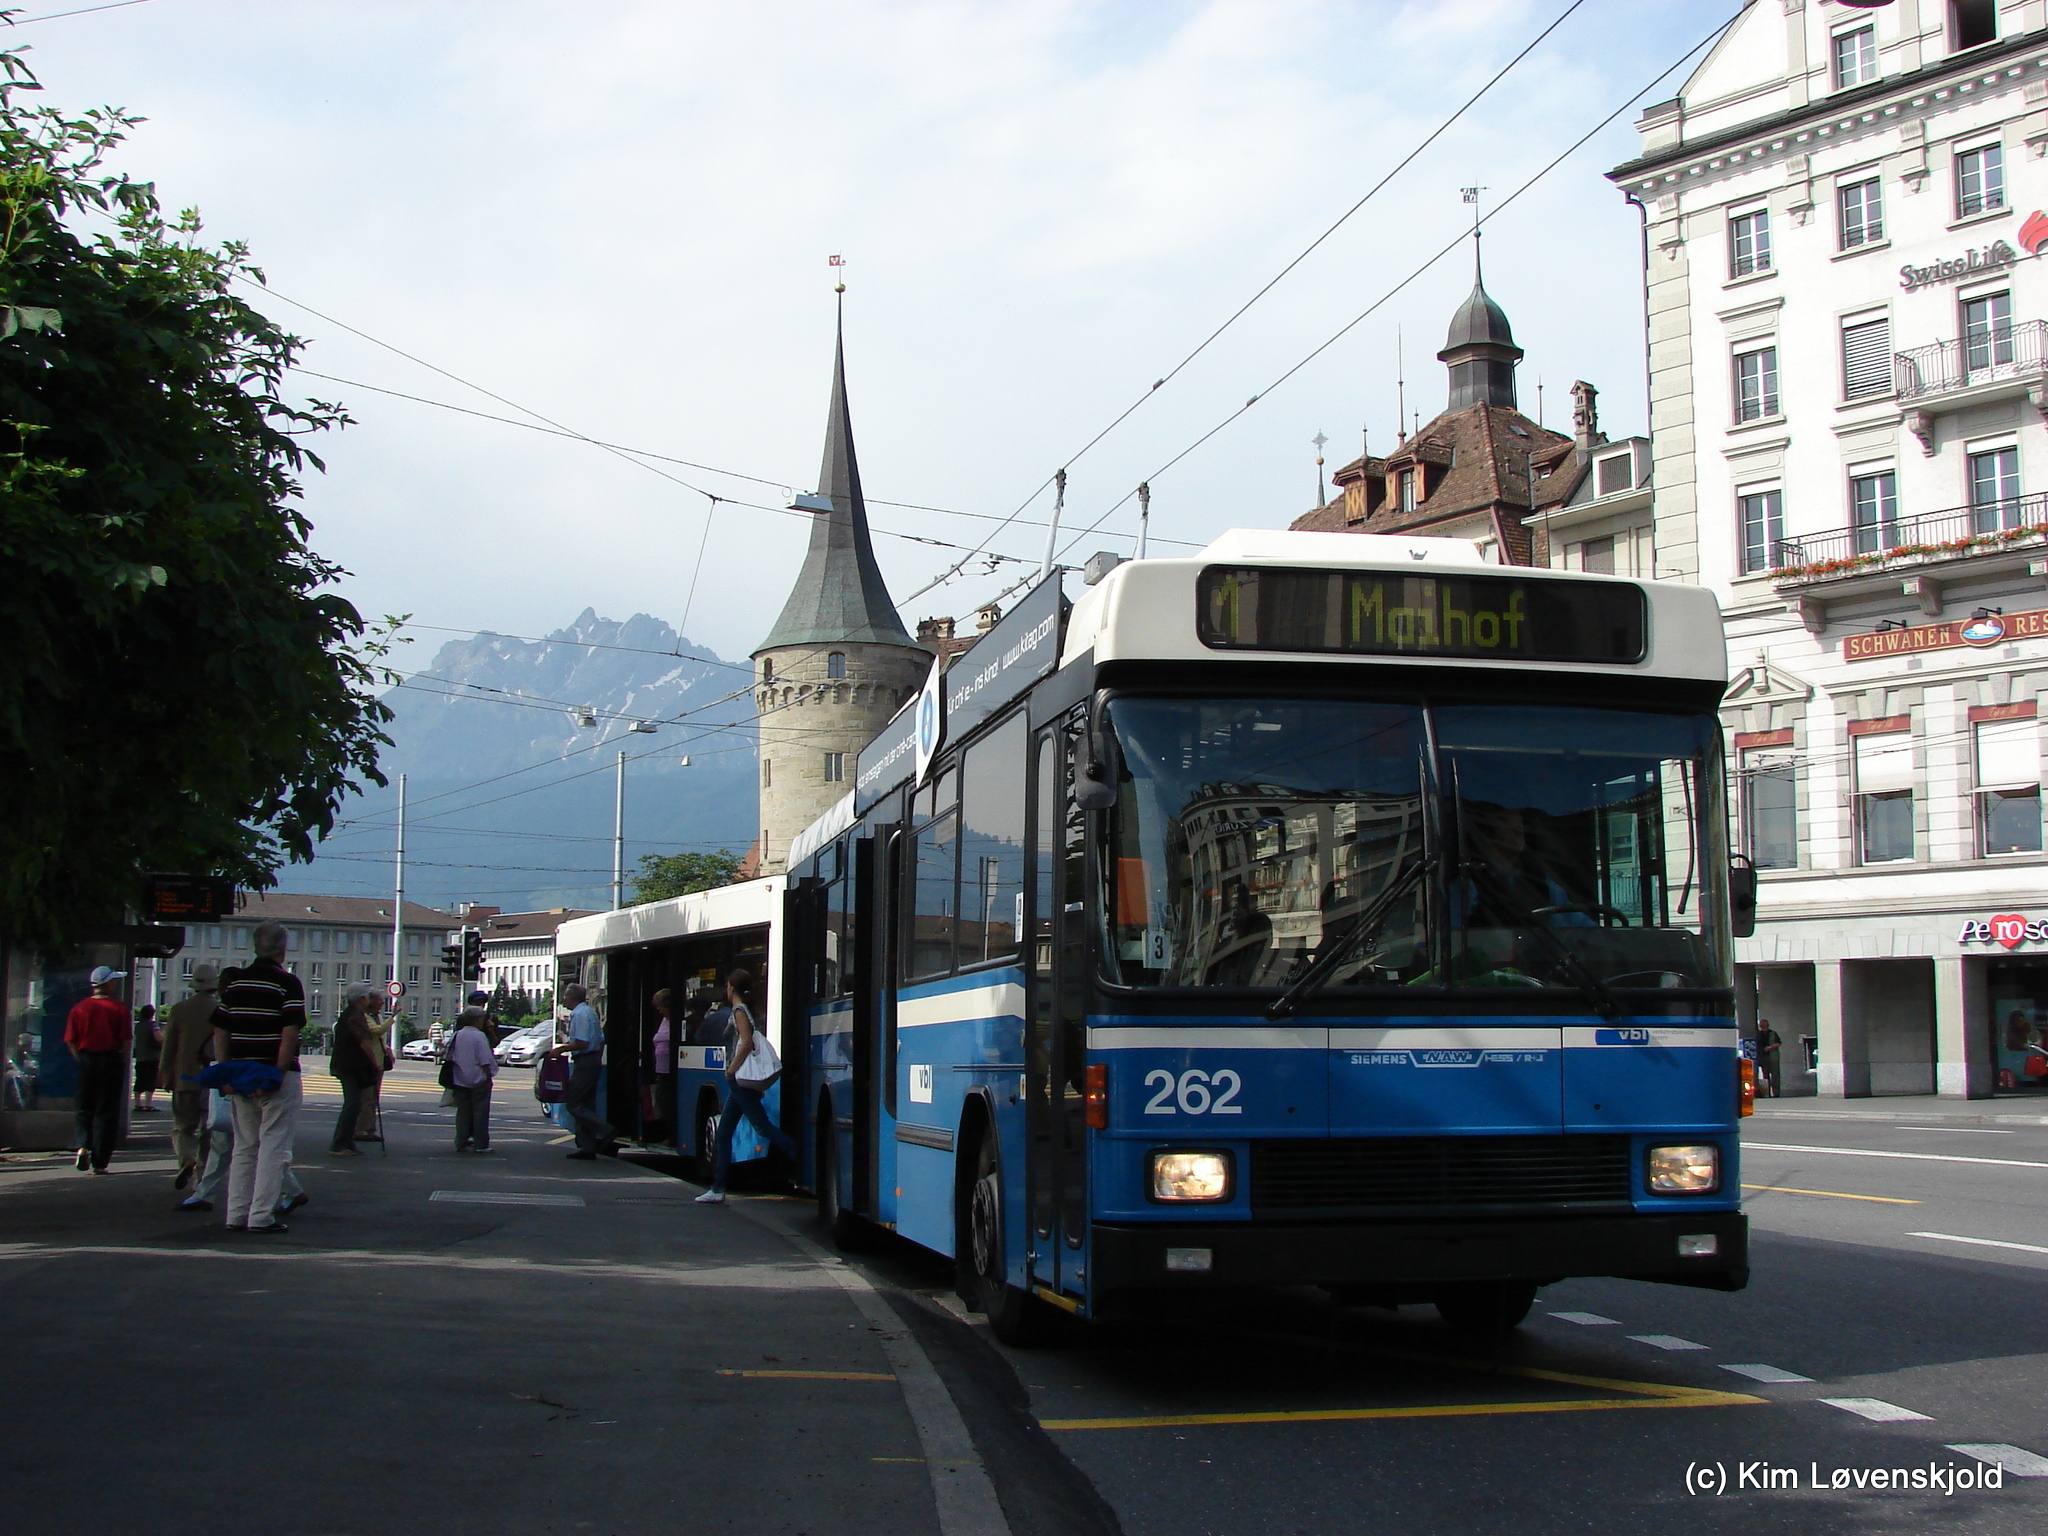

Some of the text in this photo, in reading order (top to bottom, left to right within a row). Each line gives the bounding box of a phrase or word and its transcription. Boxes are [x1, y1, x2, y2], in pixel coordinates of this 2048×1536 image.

[1351, 582, 1525, 650] Maihof
[1850, 626, 1951, 656] SCHWANEN
[1154, 935, 1164, 959] 3
[1619, 1029, 1648, 1040] vbl
[1351, 1054, 1407, 1064] SIEMENS
[1424, 1050, 1471, 1063] NAW
[919, 1064, 931, 1089] vbl
[1143, 1068, 1243, 1116] 262
